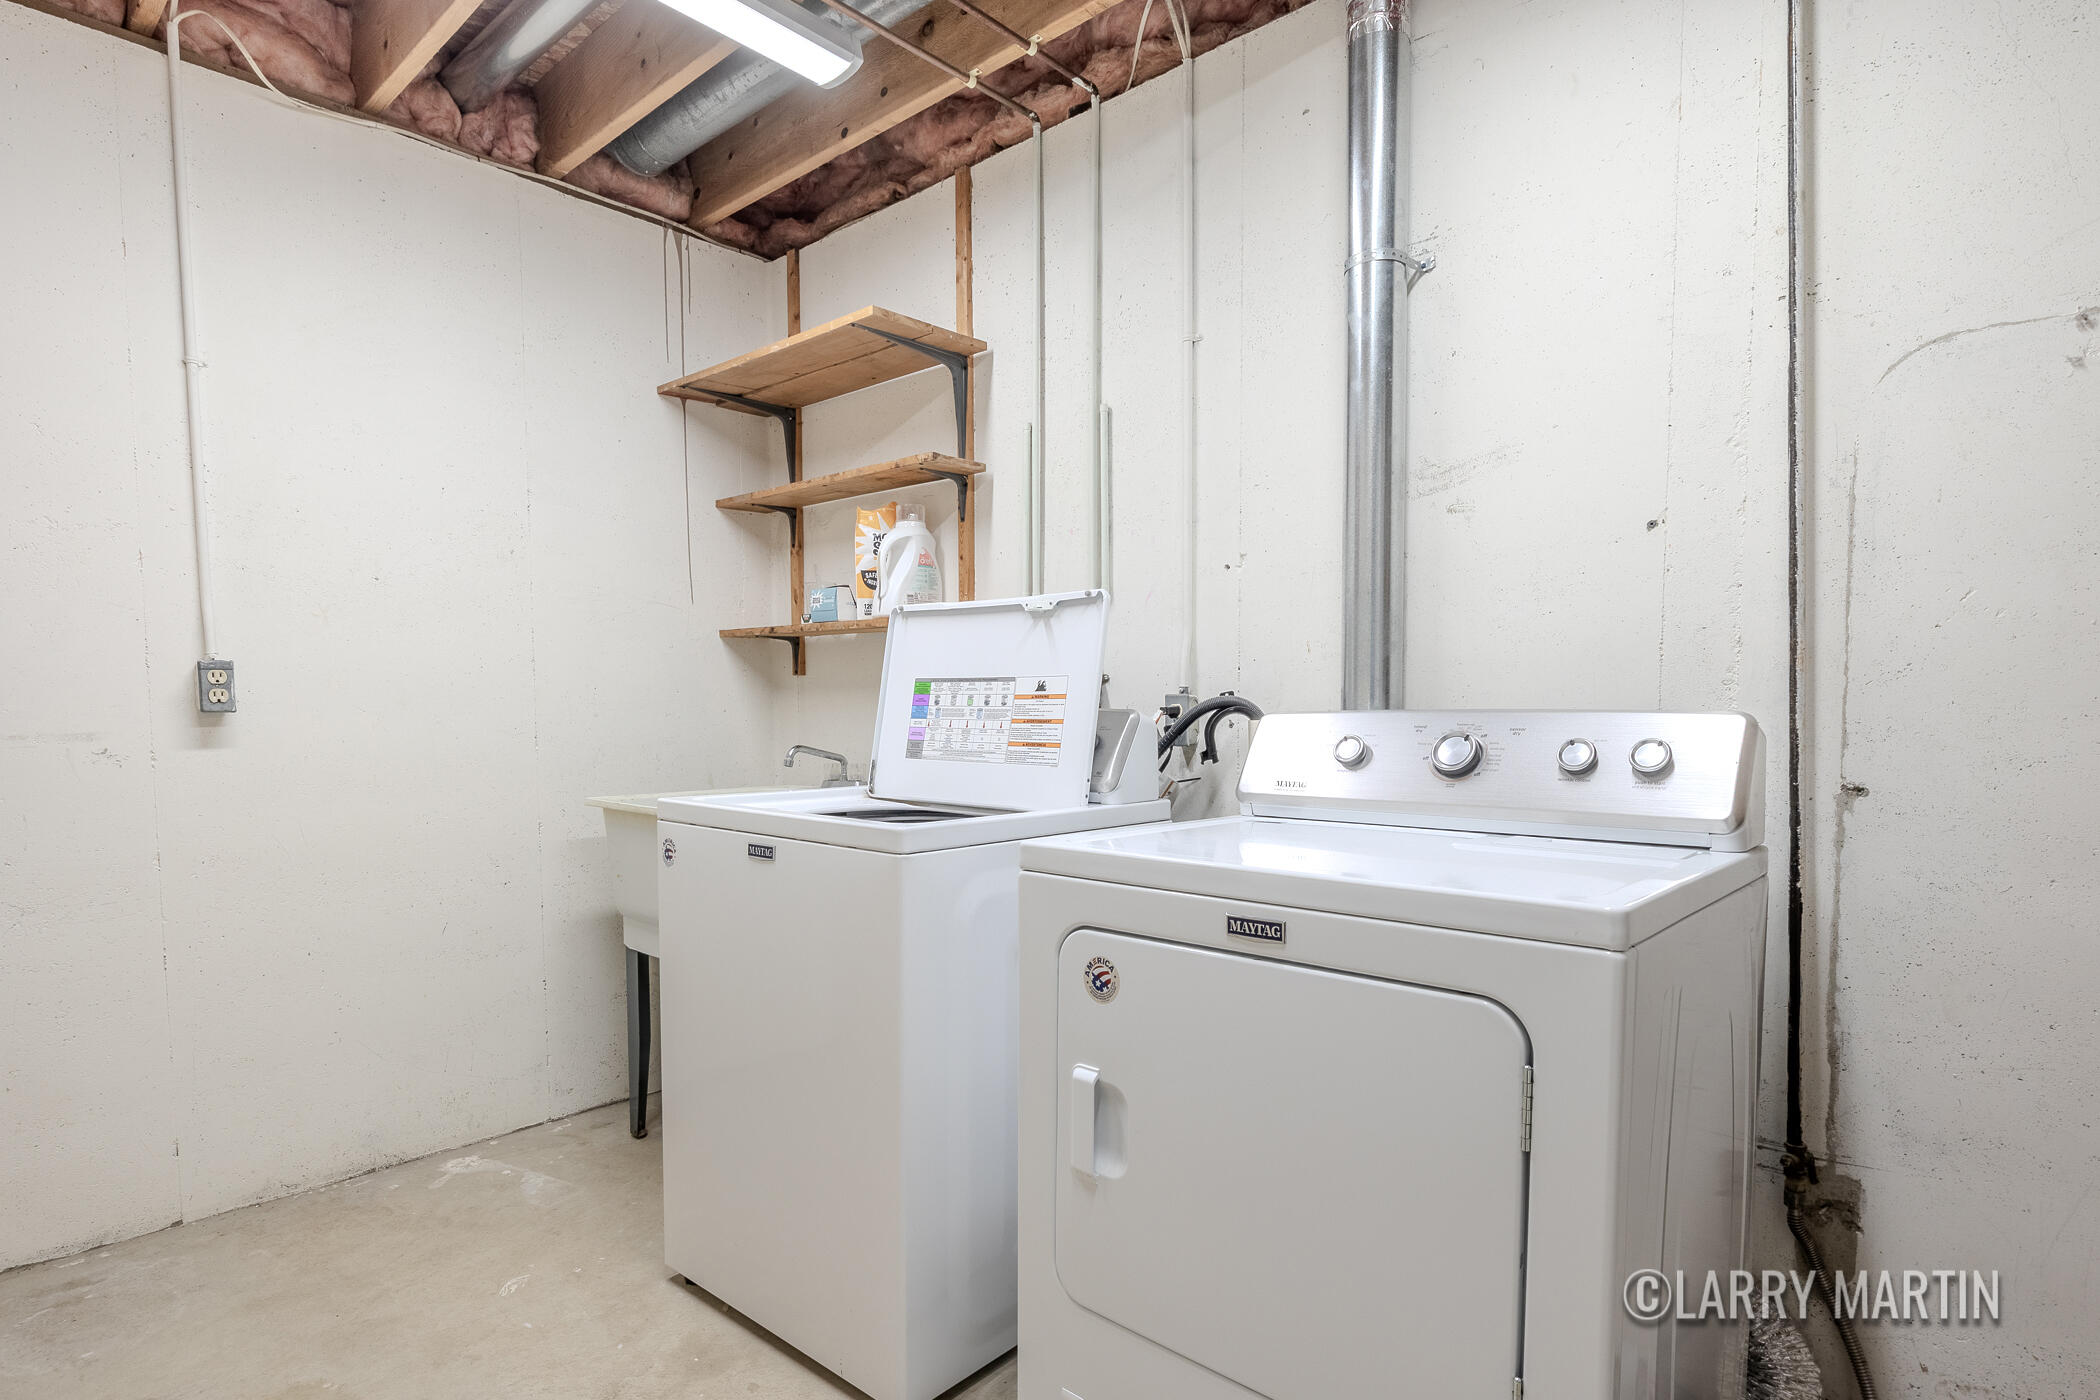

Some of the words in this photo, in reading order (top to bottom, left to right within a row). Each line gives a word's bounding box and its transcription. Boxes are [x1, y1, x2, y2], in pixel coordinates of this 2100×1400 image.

[749, 845, 773, 857] MAYTAG
[1229, 919, 1281, 938] MAYTAG
[1085, 957, 1114, 978] AMERICA
